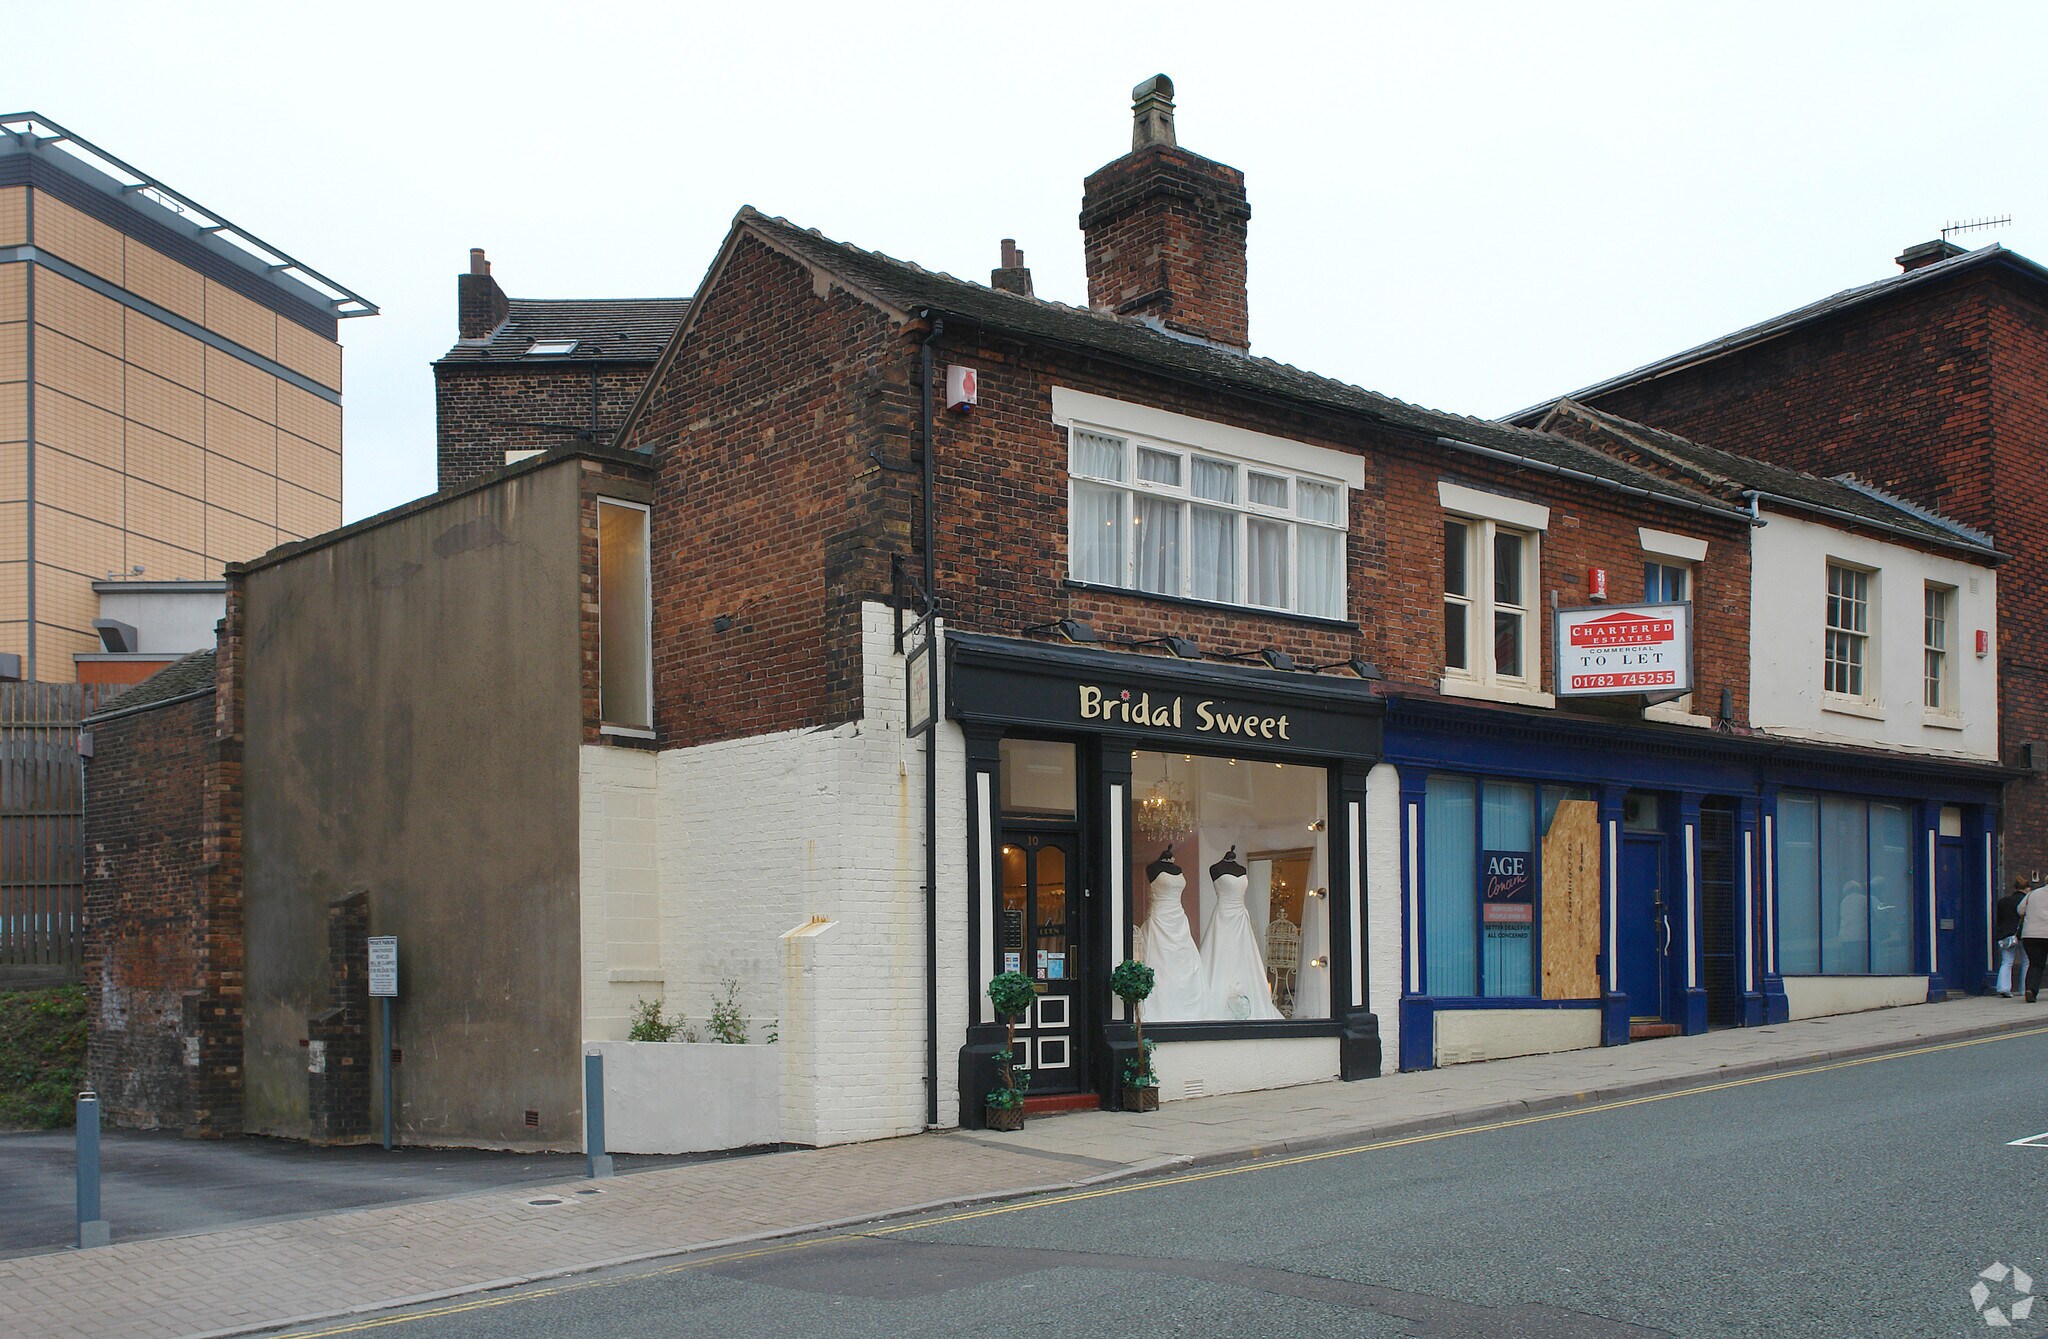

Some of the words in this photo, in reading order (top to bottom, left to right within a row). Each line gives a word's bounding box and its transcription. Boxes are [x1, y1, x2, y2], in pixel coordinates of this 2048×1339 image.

[1572, 623, 1672, 637] CHARTERED
[1593, 634, 1652, 644] ESTATES
[1590, 646, 1653, 654] COMMERCIAL
[1580, 656, 1606, 667] TO
[1623, 653, 1663, 665] LET
[1573, 675, 1614, 688] 01782
[1622, 672, 1673, 685] 745255
[1079, 685, 1182, 729] Bridal
[1196, 701, 1290, 740] Sweet
[1028, 835, 1039, 846] 10
[1487, 857, 1525, 876] AGE
